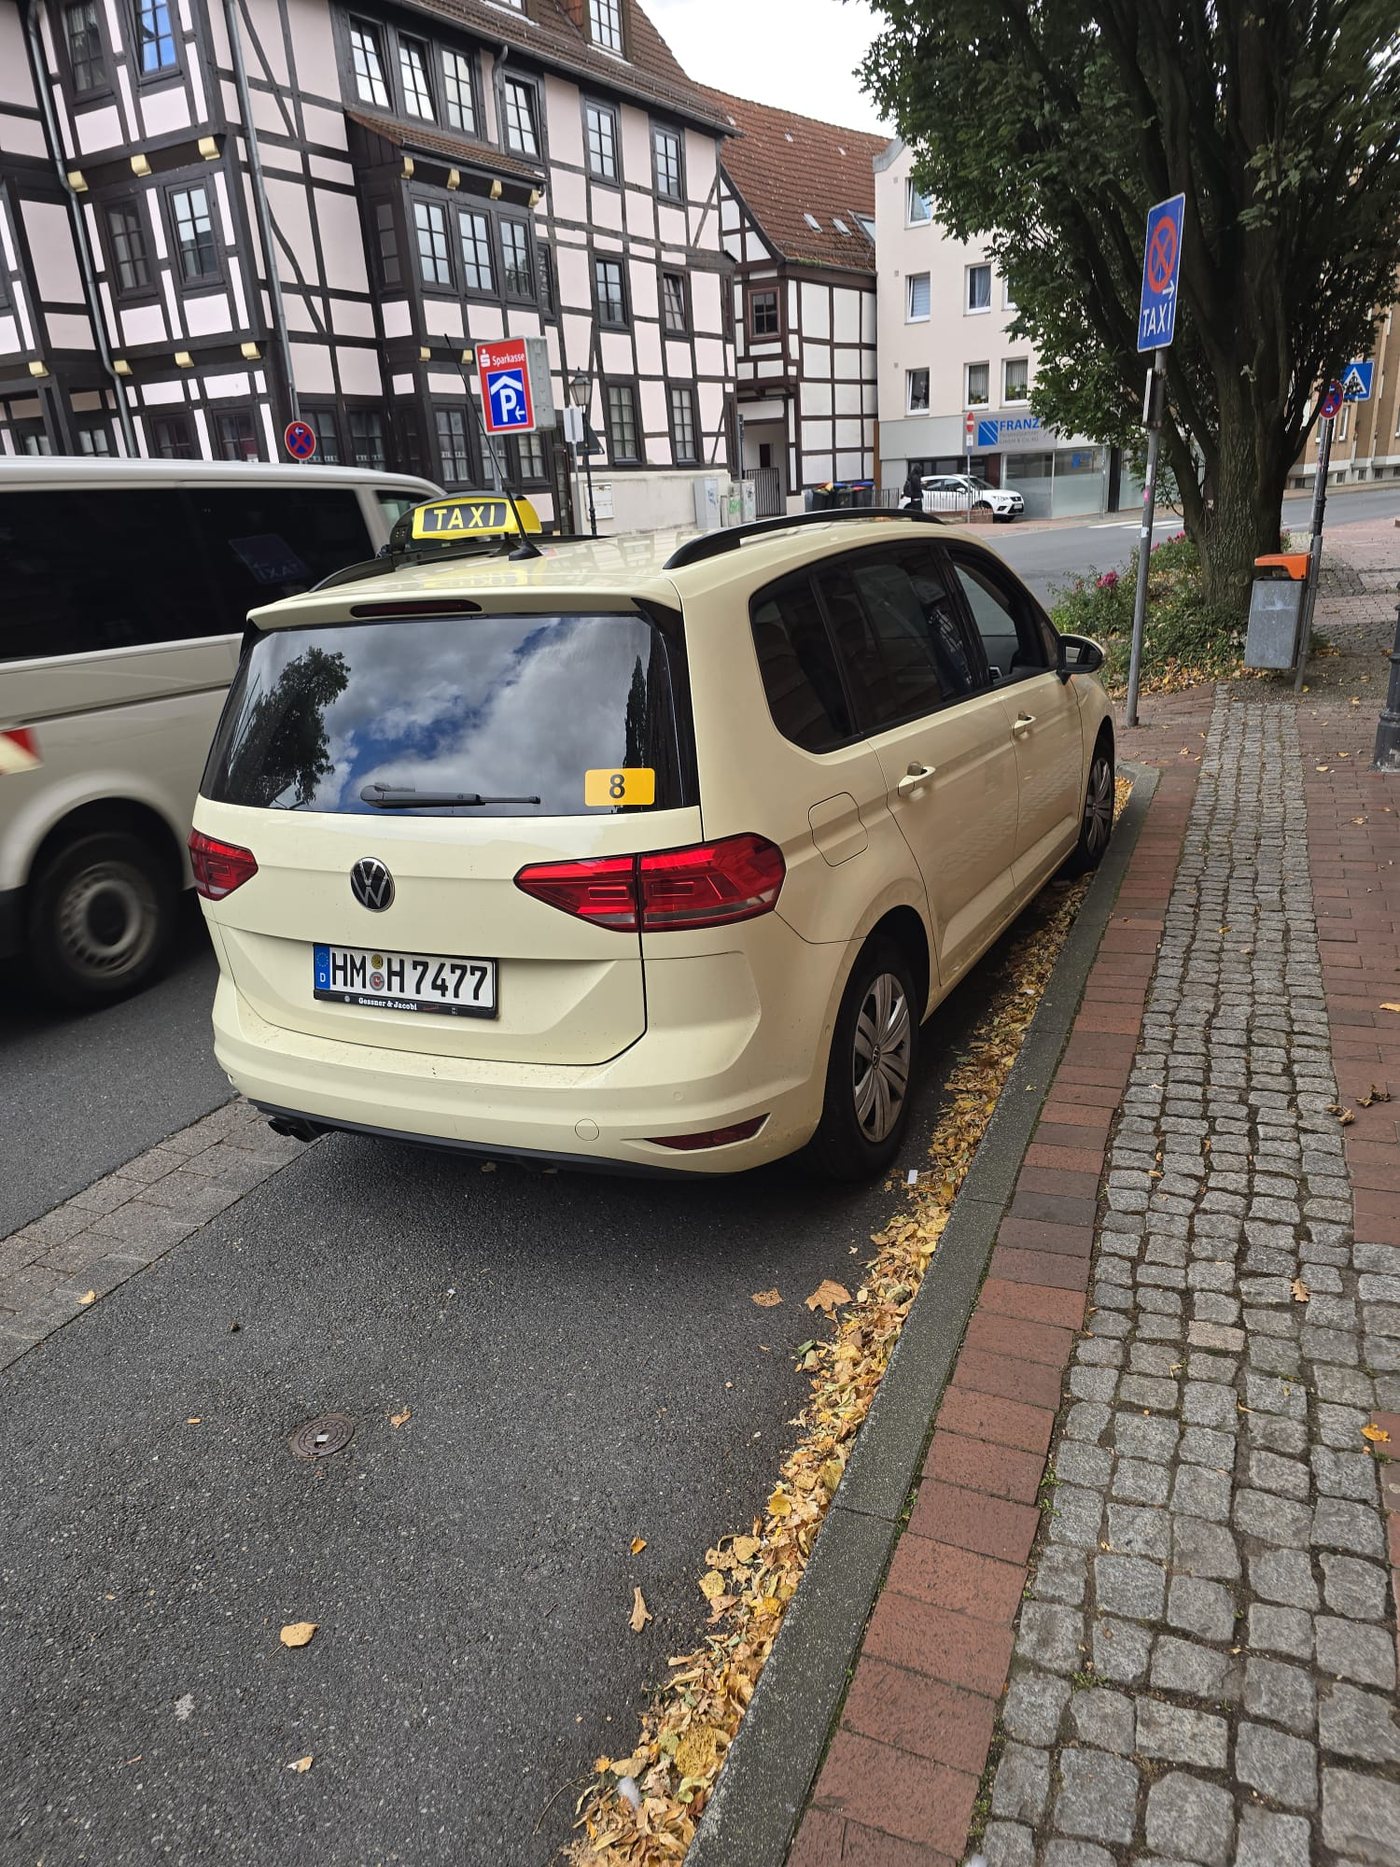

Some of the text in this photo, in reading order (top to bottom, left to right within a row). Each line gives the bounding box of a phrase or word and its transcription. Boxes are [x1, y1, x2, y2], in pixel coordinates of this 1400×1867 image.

[1142, 301, 1173, 338] TAXI
[492, 352, 526, 367] Sparkasse
[499, 388, 517, 422] P
[1000, 418, 1040, 431] FRANZ
[433, 505, 496, 530] TAXI
[609, 774, 625, 799] 8
[351, 858, 393, 911] VW
[319, 972, 326, 983] D
[331, 952, 367, 989] HM
[358, 998, 386, 1008] Gessner
[386, 1000, 394, 1008] &
[394, 1001, 418, 1011] Jacobi
